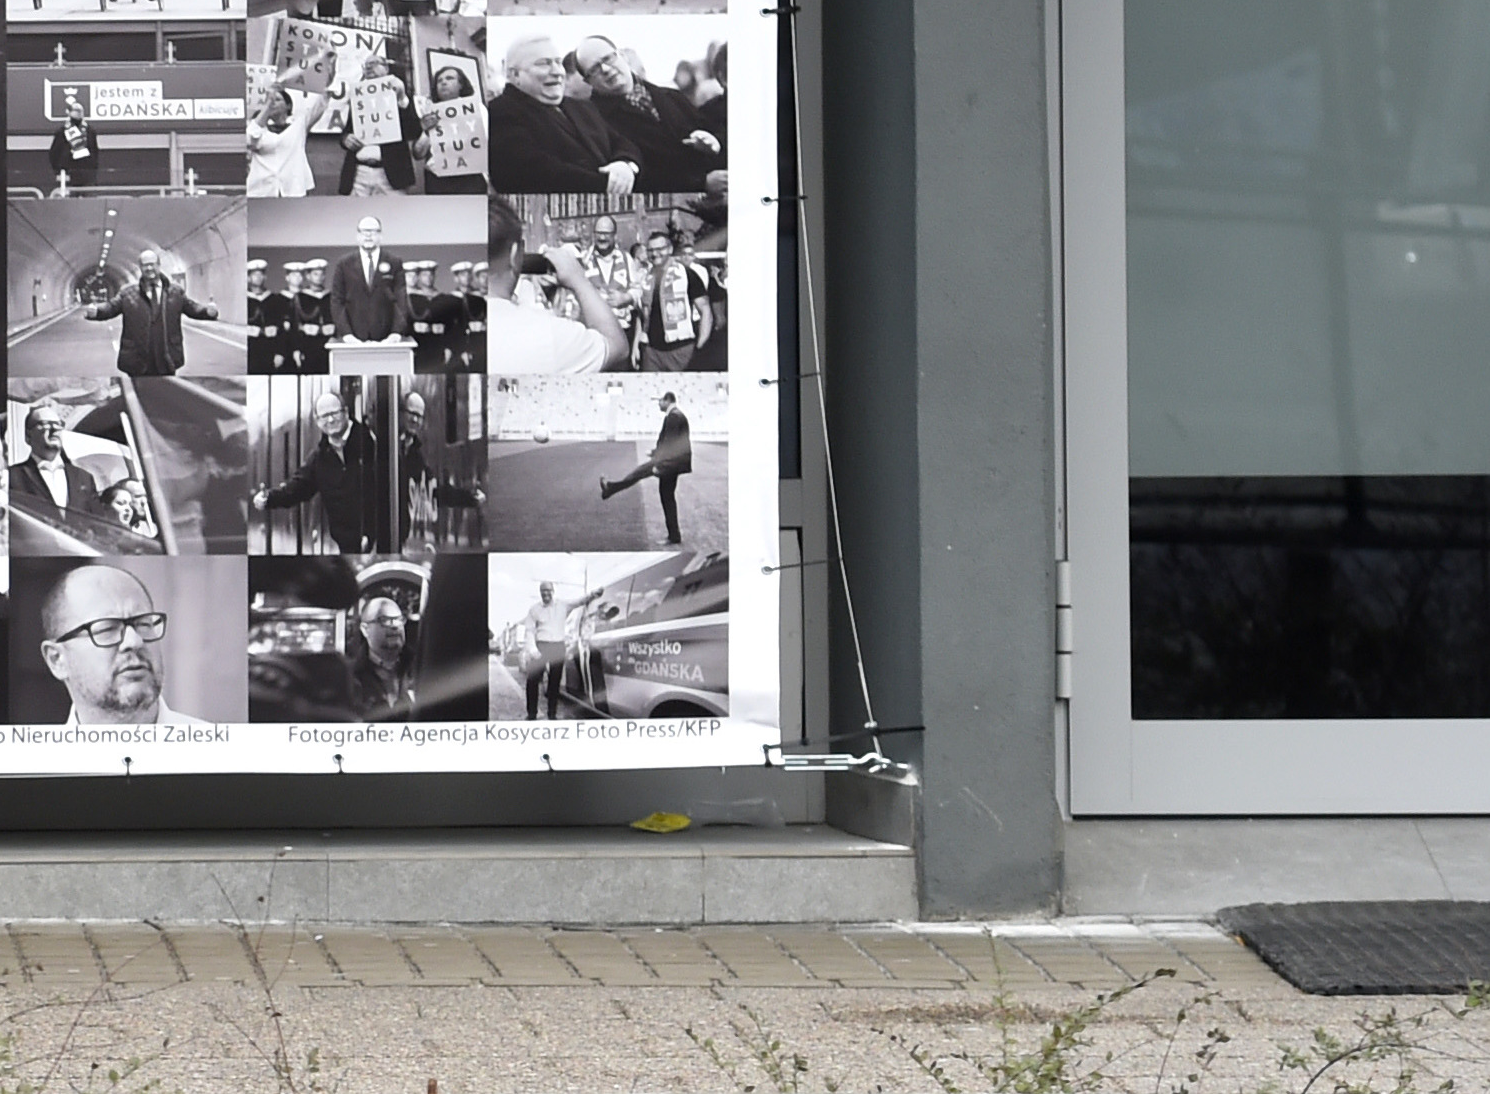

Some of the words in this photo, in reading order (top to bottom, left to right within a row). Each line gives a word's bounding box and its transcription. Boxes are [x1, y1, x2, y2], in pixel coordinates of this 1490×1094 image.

[94, 86, 144, 100] jestem
[150, 86, 158, 97] z
[95, 100, 188, 118] GDAŃSKA
[12, 724, 157, 744] Nieruchomości
[163, 724, 229, 743] Zaleski
[287, 724, 394, 747] Fotografie:
[400, 724, 478, 746] Agencja
[485, 722, 570, 745] Kosycarz
[576, 721, 620, 739] Foto
[626, 718, 721, 738] Press/KFP
